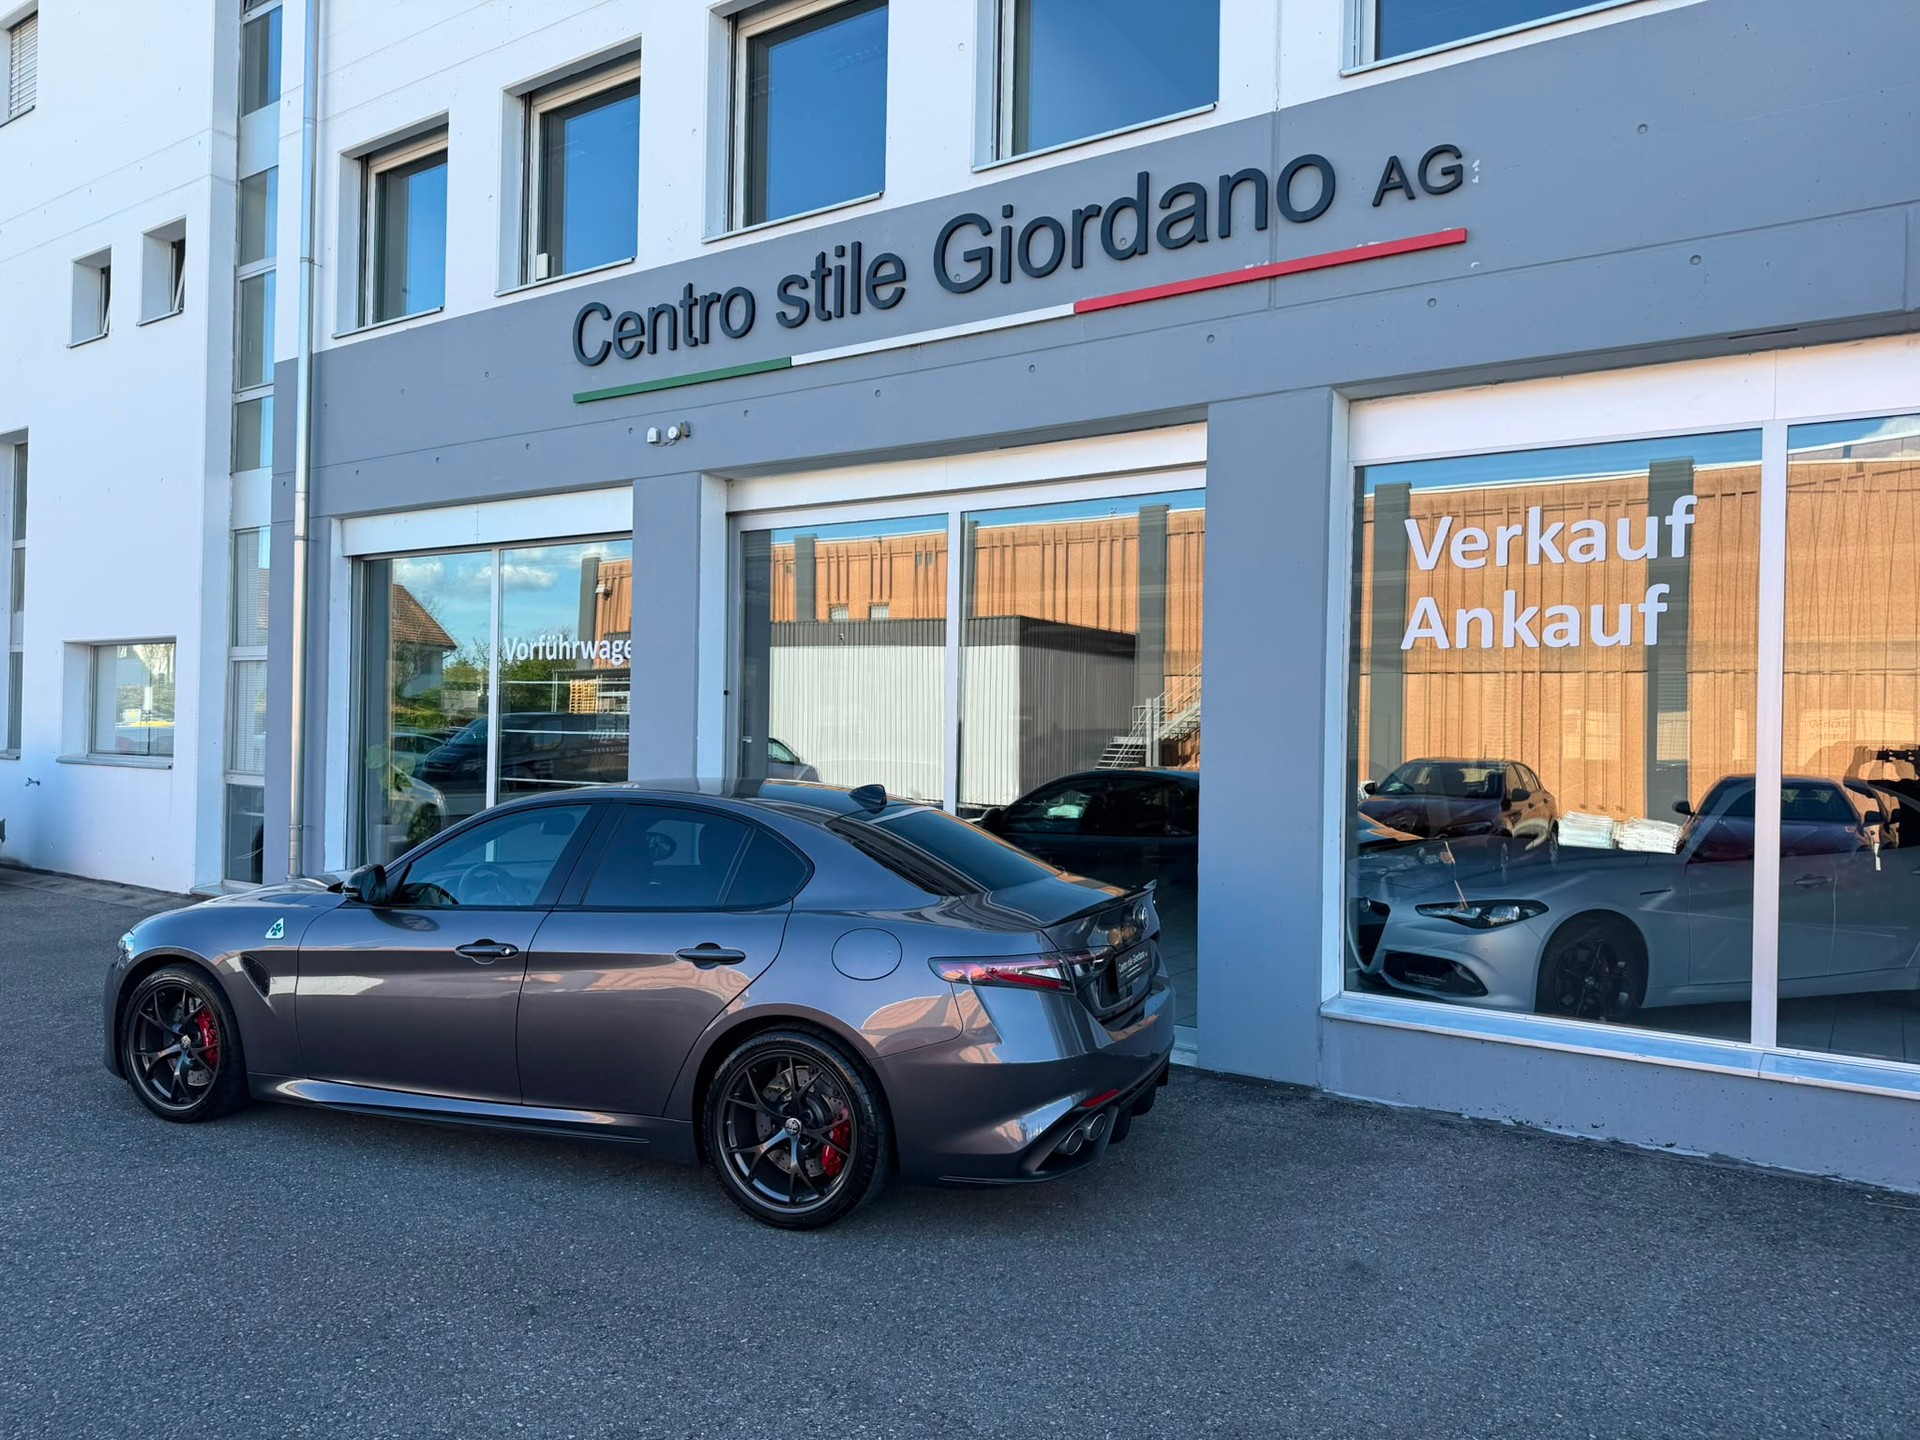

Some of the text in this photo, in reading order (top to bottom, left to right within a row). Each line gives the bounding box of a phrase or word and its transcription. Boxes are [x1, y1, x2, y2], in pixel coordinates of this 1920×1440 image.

[572, 143, 1464, 367] Centro stile Giordano AG
[1404, 494, 1698, 571] Verkauf
[1400, 583, 1670, 650] Ankauf
